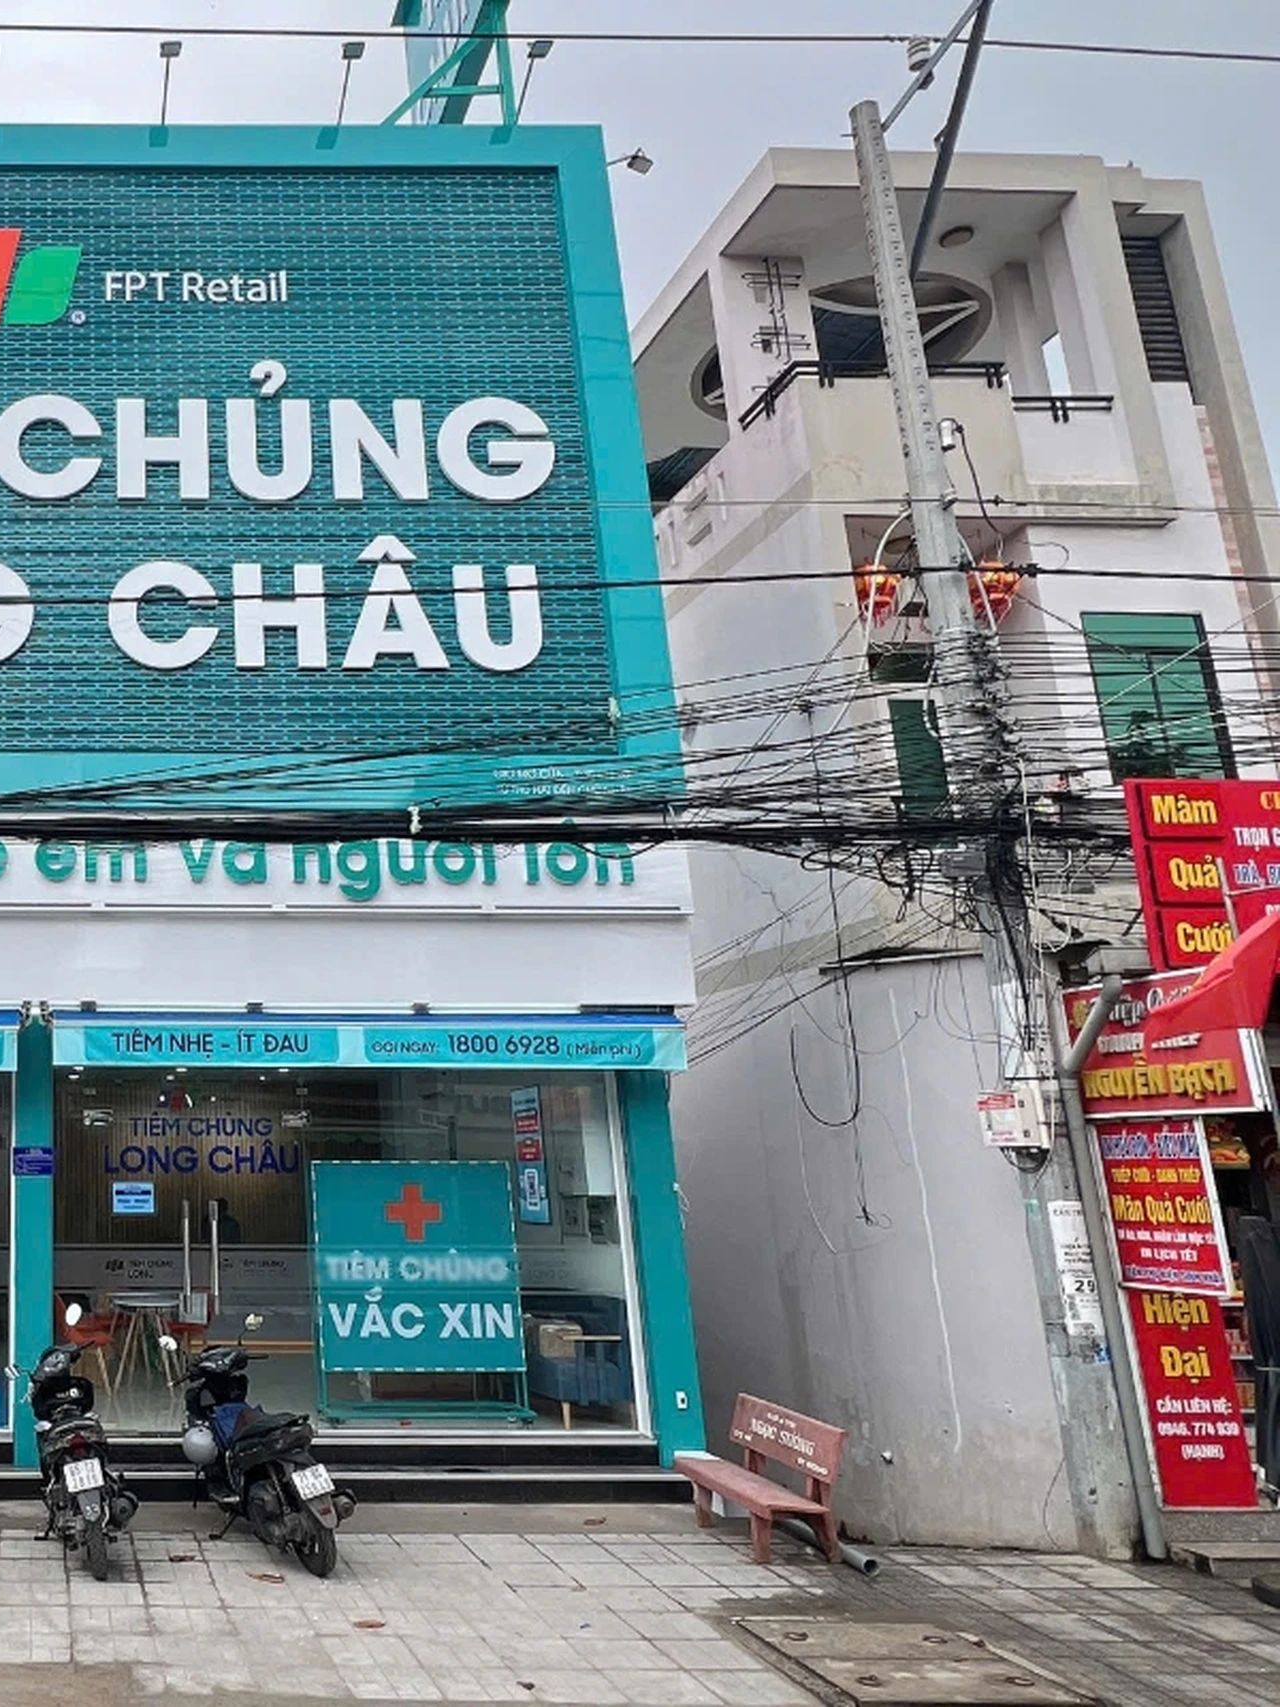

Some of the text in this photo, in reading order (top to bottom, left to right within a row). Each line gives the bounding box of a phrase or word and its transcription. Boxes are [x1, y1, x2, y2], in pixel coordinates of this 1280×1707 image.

[105, 270, 288, 302] FPT Retail
[107, 535, 545, 671] CHÂU
[1151, 795, 1217, 824] Mâm
[1169, 854, 1219, 891] Quả
[111, 1028, 163, 1053] TIÊM
[170, 1033, 214, 1060] NHẸ
[237, 1028, 256, 1053] ÍT
[262, 1033, 309, 1053] ĐAU
[448, 1034, 498, 1054] 1800
[505, 1034, 560, 1055] 6928
[128, 1112, 273, 1136] TIÊM CHỦNG
[104, 1139, 300, 1174] LONG CHÂU
[325, 1250, 389, 1280] TIÊM
[328, 1286, 515, 1339] VẮC XIN
[1143, 1292, 1210, 1331] Hiện
[1160, 1346, 1211, 1384] Đại
